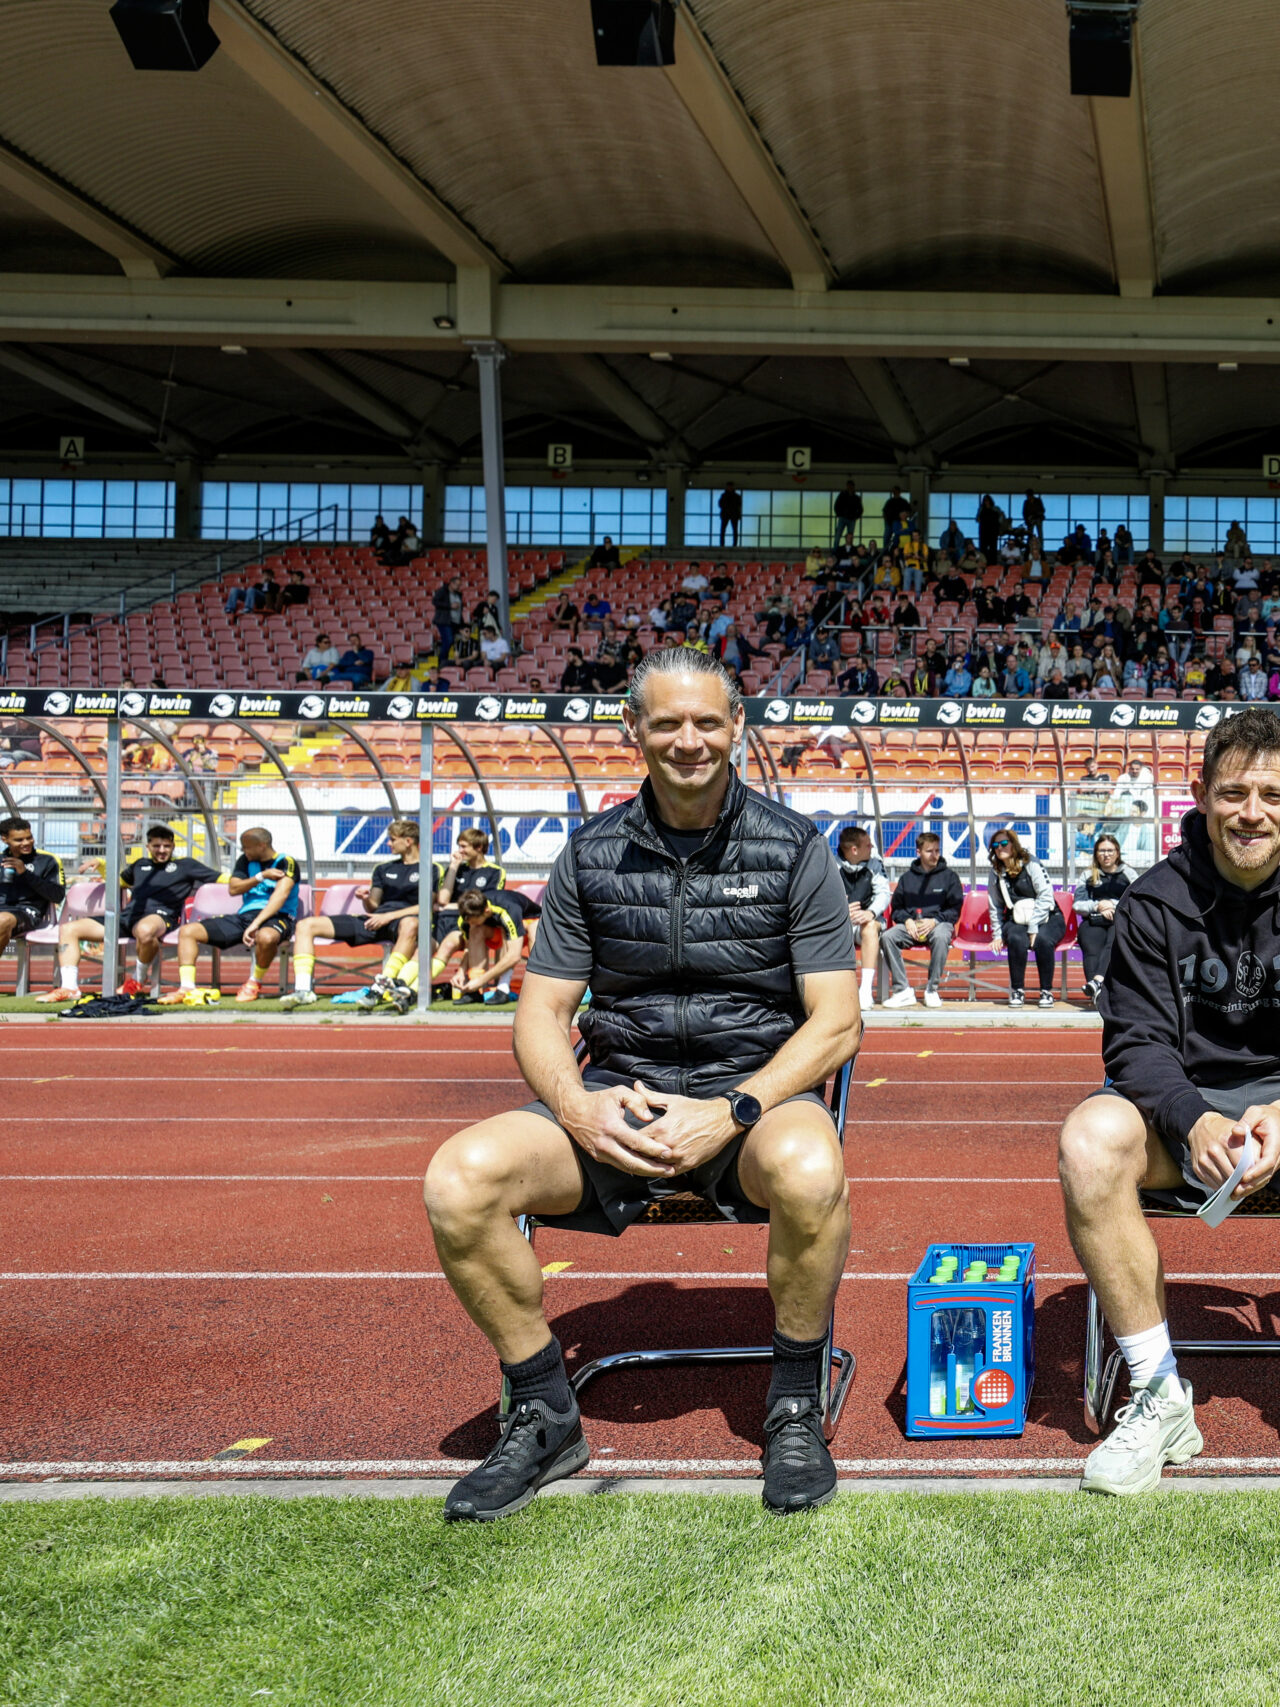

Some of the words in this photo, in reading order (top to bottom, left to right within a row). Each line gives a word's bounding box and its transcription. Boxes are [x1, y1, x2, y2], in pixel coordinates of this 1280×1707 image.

[64, 439, 79, 457] A
[553, 446, 567, 464] B
[792, 449, 805, 467] C
[0, 692, 26, 708] win
[75, 693, 117, 708] bwin
[150, 694, 192, 711] bwin
[239, 696, 281, 711] bwin
[328, 697, 370, 712] bwin
[417, 697, 458, 713] bwin
[505, 698, 547, 714] bwin
[593, 700, 623, 715] bwi
[793, 701, 834, 716] bwin
[880, 702, 920, 718] bwin
[966, 703, 1006, 718] bwin
[1052, 704, 1092, 720] bwin
[1139, 705, 1179, 721] bwin
[1183, 992, 1270, 1014] pielvereinigung
[992, 1310, 1002, 1362] FRANKEN
[1002, 1310, 1012, 1362] BRUNNEN
